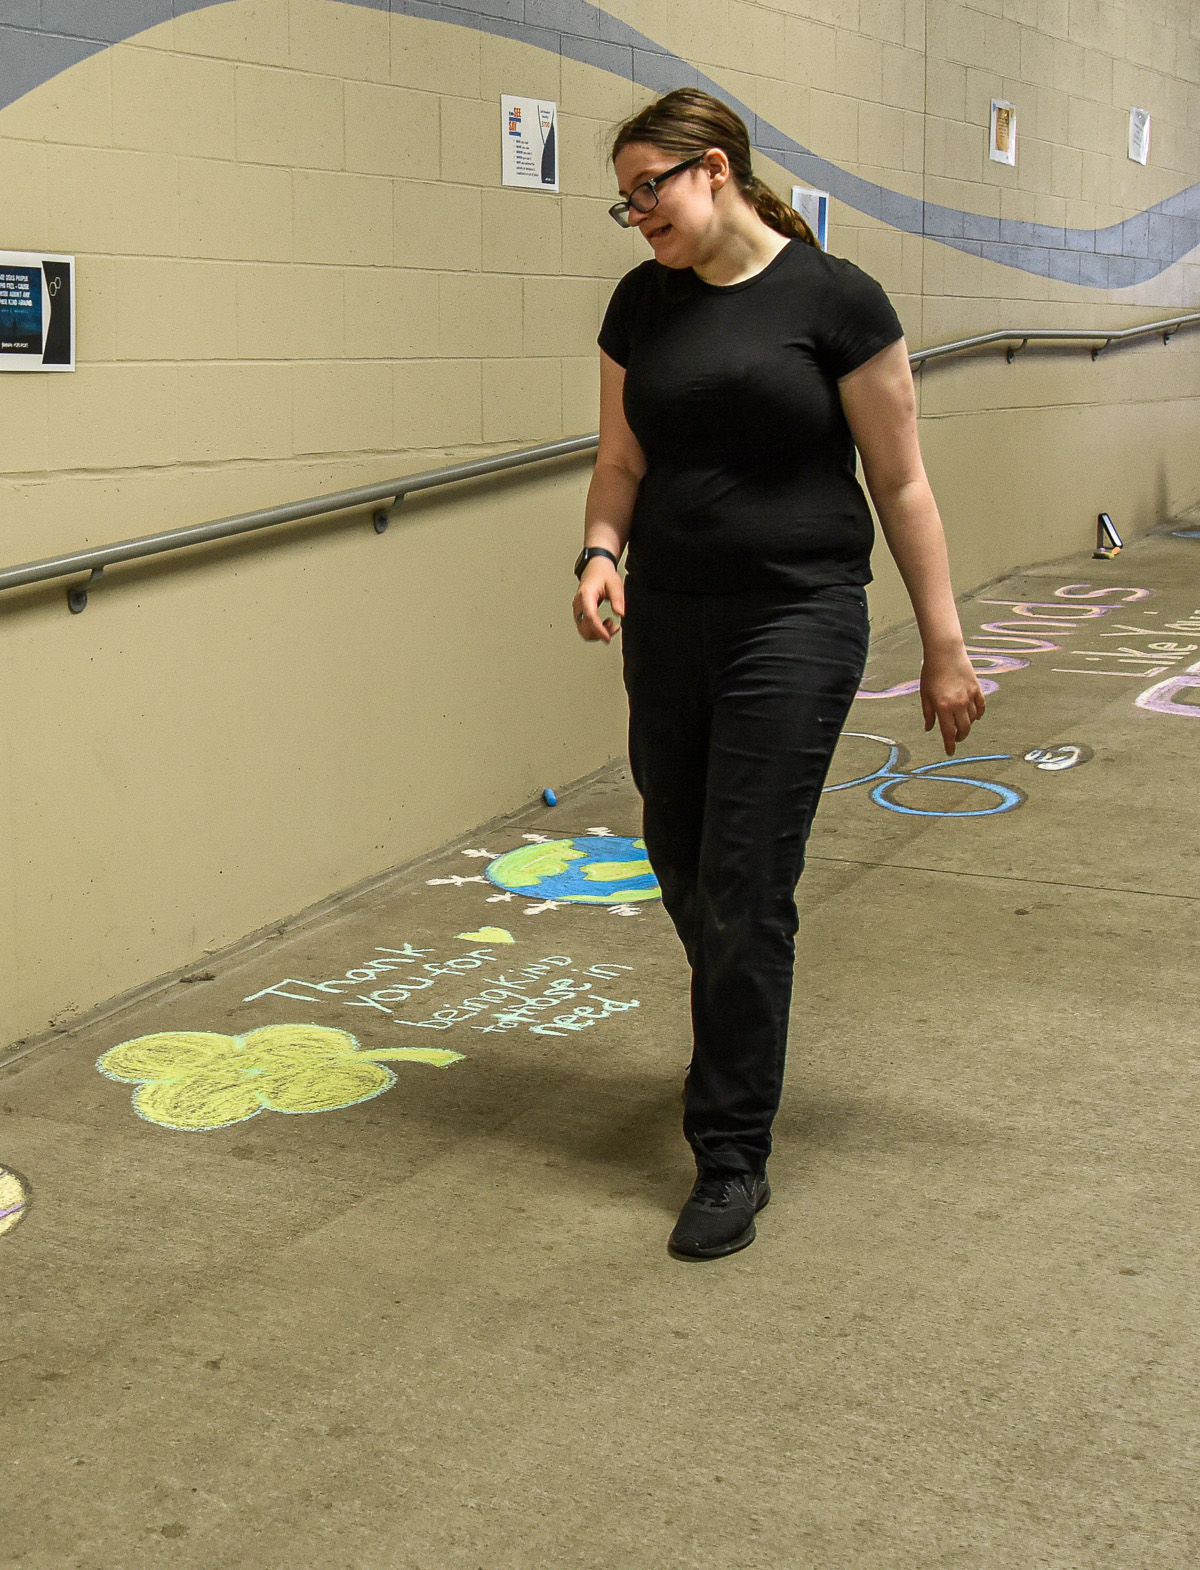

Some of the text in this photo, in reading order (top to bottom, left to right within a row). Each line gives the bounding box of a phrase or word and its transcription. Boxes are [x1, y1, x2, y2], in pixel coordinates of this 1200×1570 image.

[243, 942, 435, 1002] Thank
[423, 949, 497, 977] for
[571, 962, 634, 980] in
[394, 988, 534, 1030] being
[529, 994, 640, 1037] need
